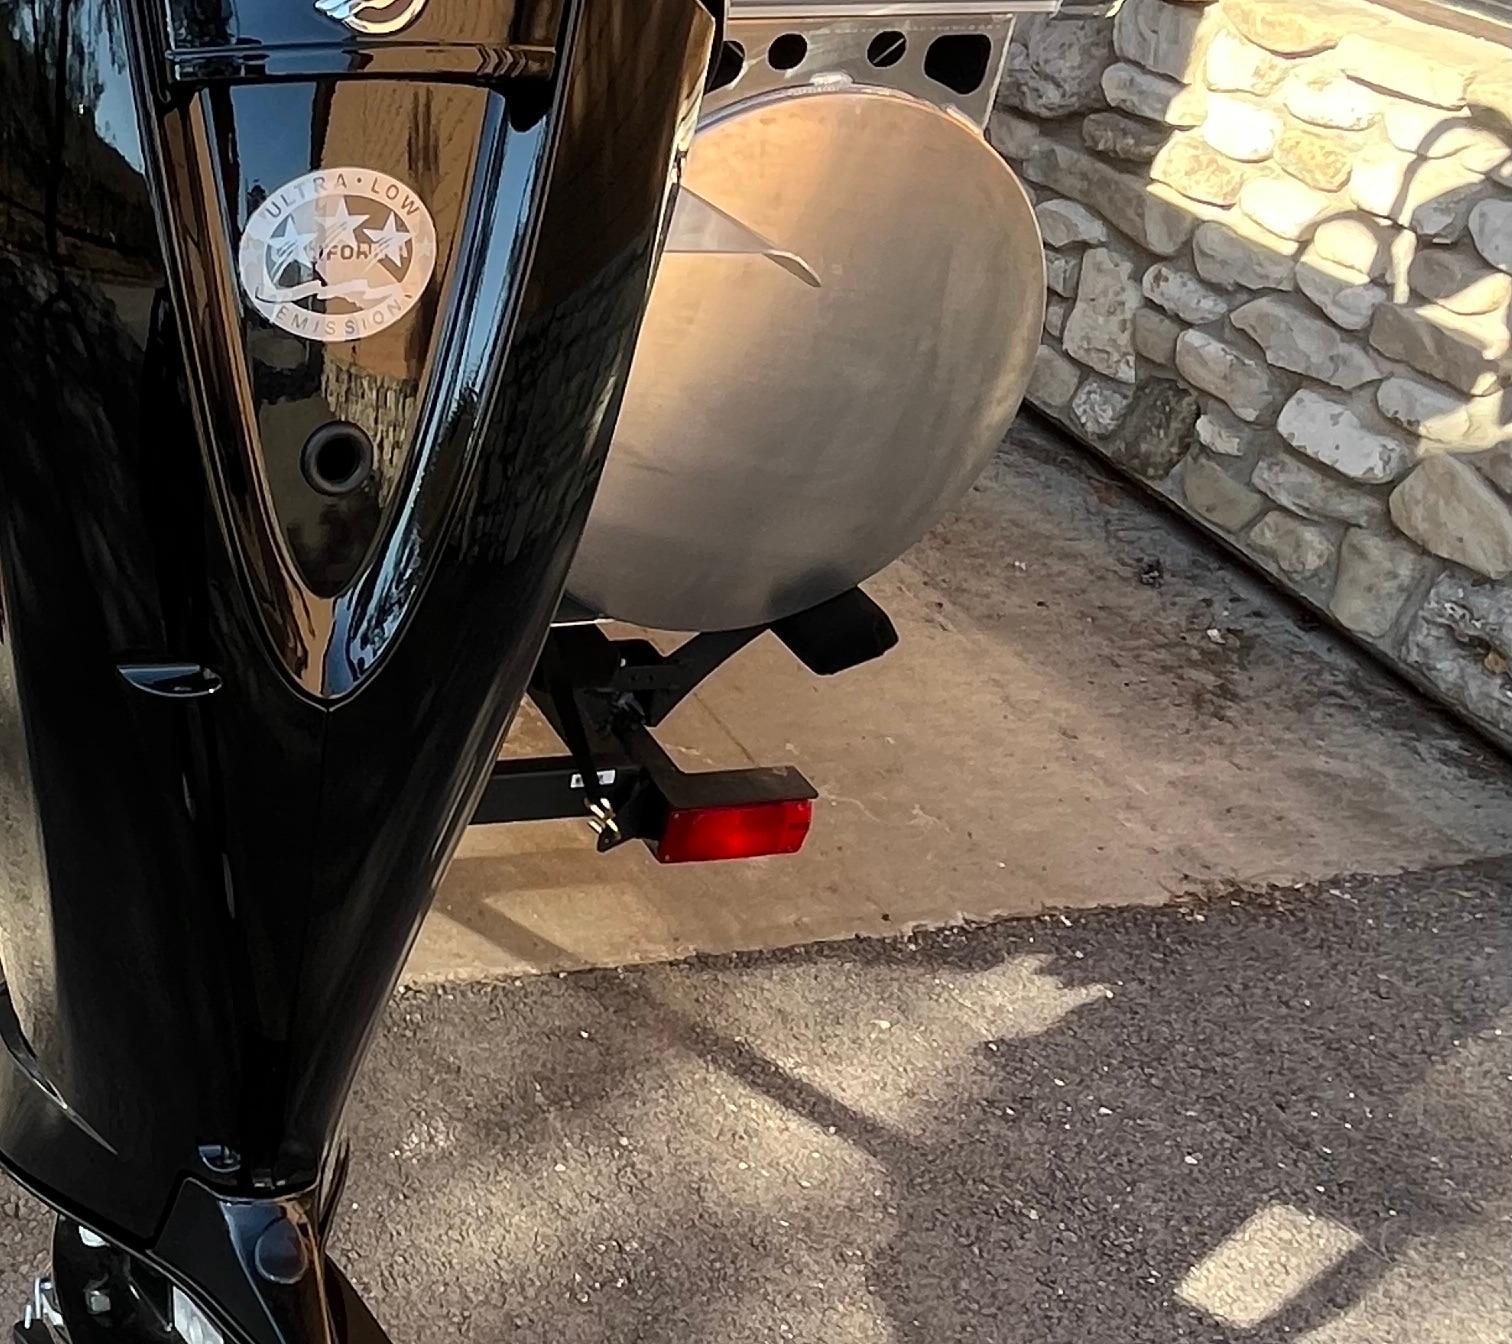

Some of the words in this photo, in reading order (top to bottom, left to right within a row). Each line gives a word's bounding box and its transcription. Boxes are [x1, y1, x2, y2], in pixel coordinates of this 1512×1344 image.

[265, 172, 348, 218] ULTRA
[370, 176, 420, 216] LOW
[275, 298, 402, 335] EMISSION
